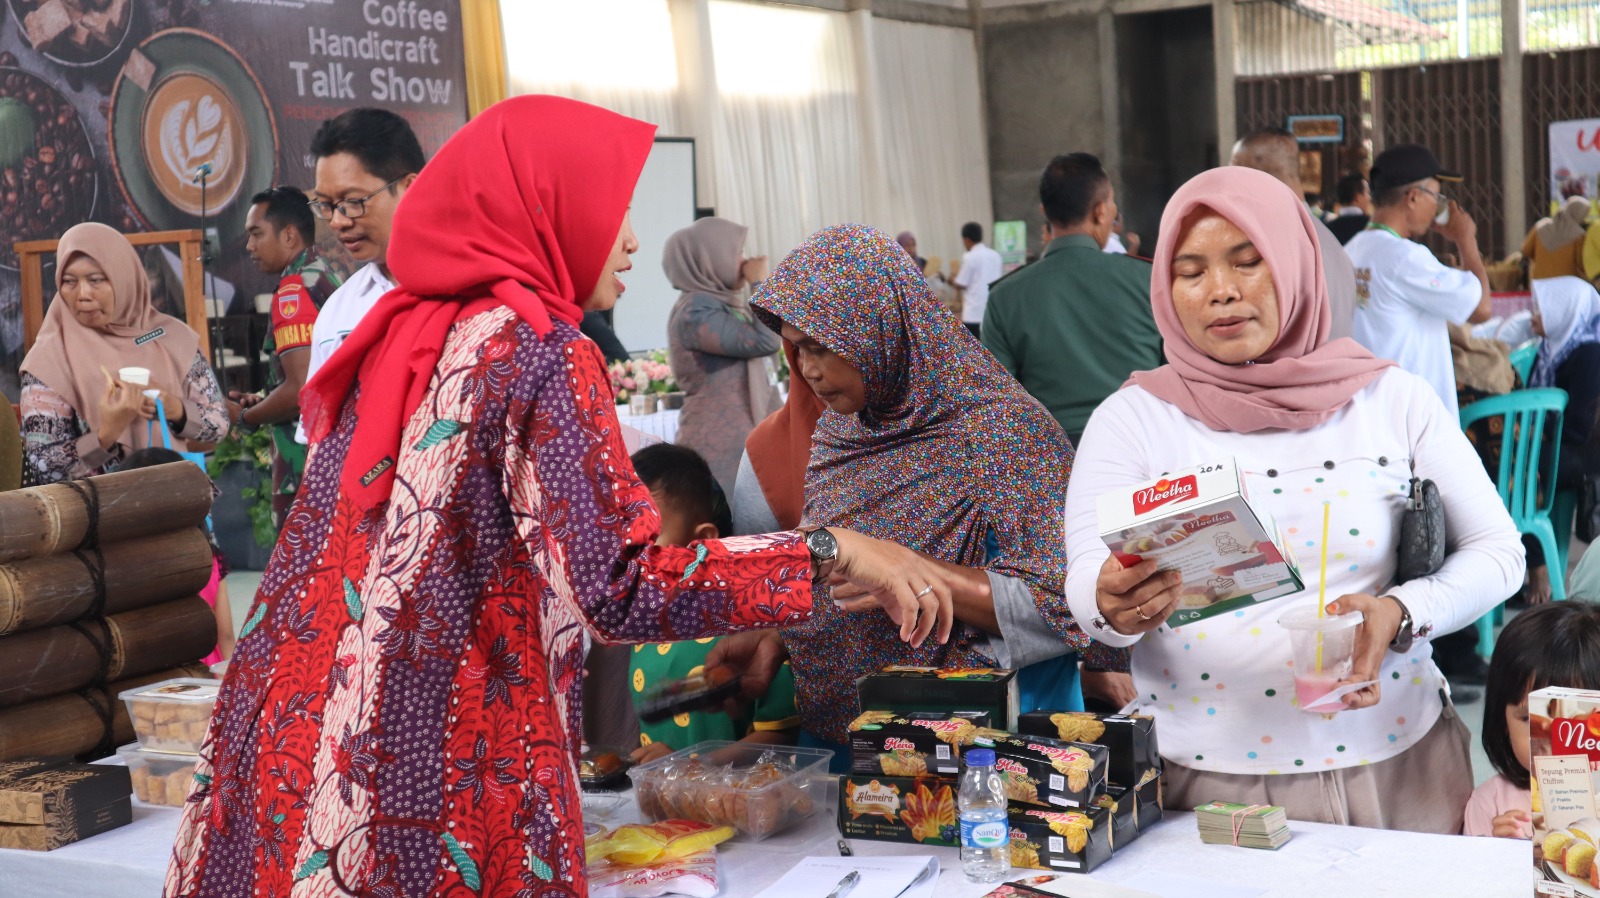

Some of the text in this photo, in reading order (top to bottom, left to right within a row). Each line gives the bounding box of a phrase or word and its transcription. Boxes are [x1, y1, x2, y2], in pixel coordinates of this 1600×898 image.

[363, 0, 447, 31] Coffee
[308, 27, 440, 64] Handicraft
[289, 61, 452, 104] Talk Show
[1200, 466, 1213, 474] 20
[1138, 481, 1192, 505] Neetha
[1186, 514, 1230, 529] Neetha
[884, 737, 915, 750] Meira
[1027, 743, 1083, 762] Meira
[996, 757, 1028, 774] Meira
[1541, 768, 1563, 776] Tepung
[856, 790, 894, 803] Alameira
[1008, 827, 1028, 839] eira
